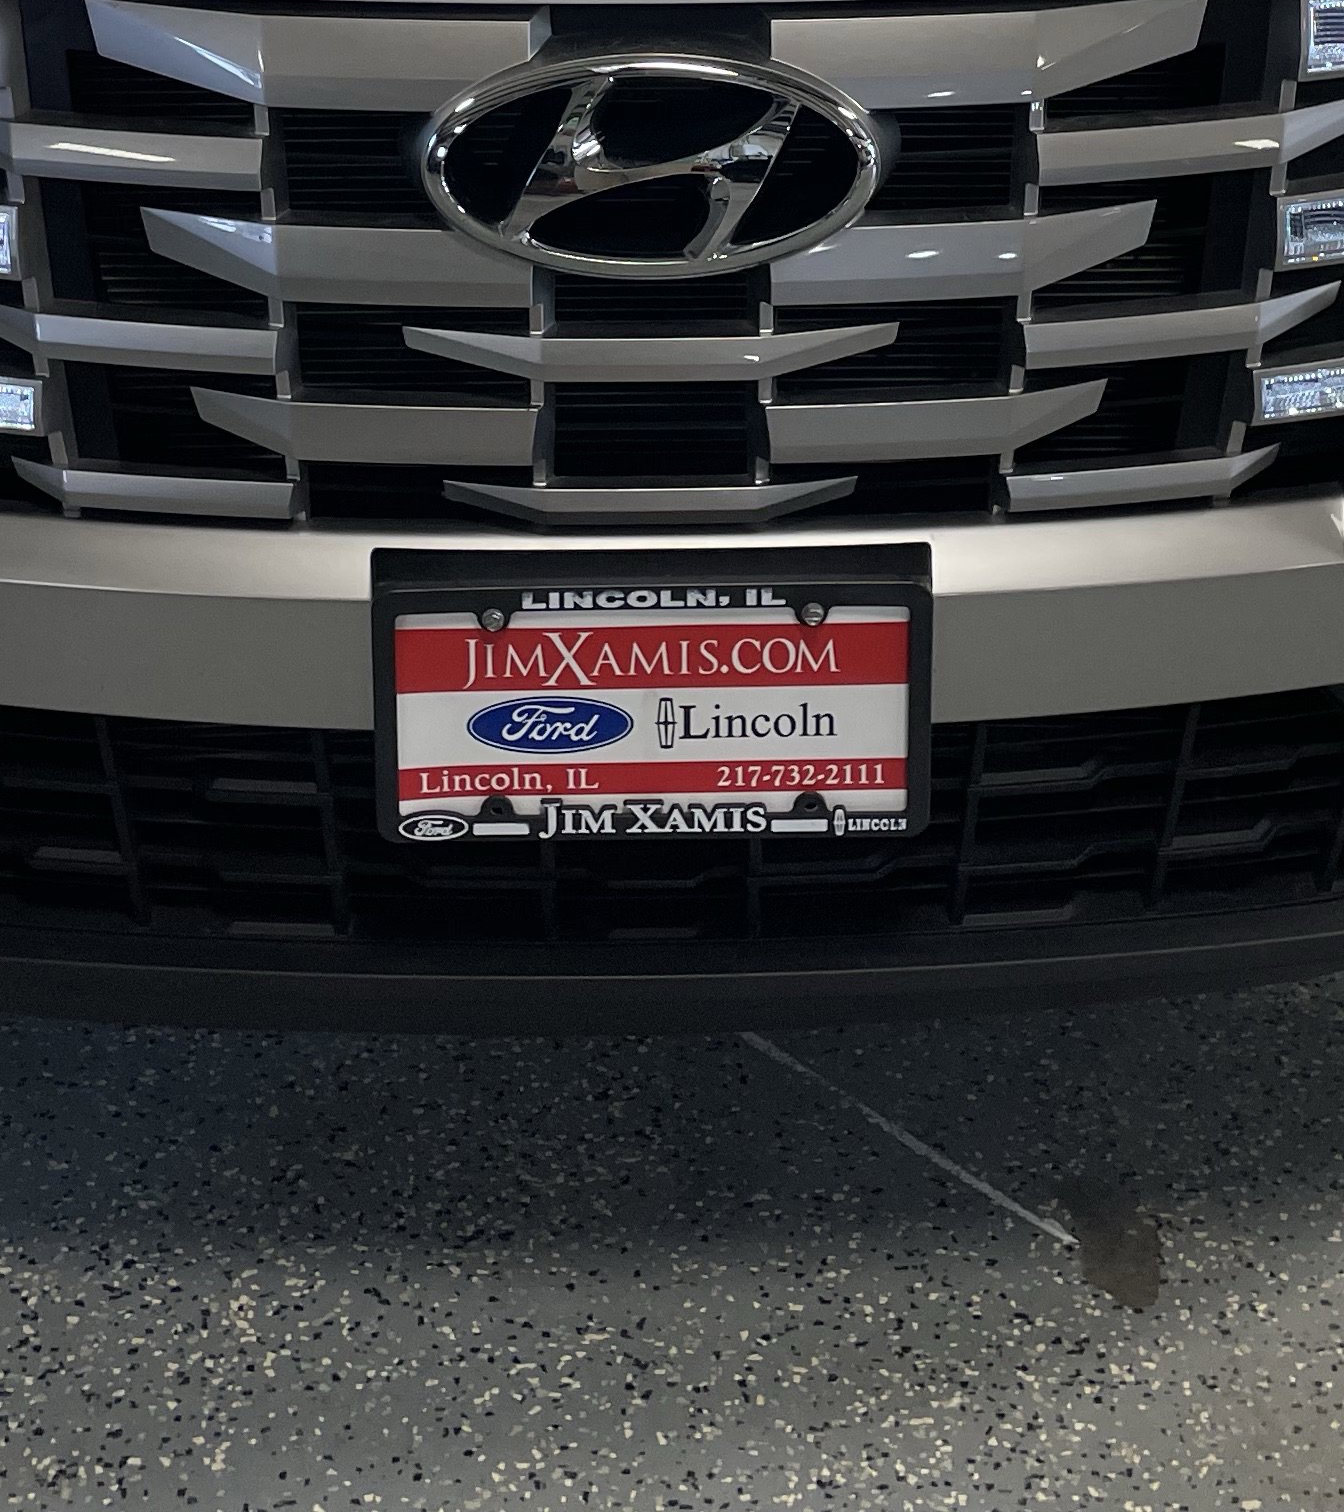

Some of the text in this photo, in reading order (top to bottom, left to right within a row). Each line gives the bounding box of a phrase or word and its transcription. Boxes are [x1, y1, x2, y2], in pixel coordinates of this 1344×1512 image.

[521, 588, 786, 610] LINCOLN, IL
[501, 704, 600, 743] Ford
[679, 703, 838, 741] Lincoln
[419, 769, 599, 794] Lincoln, IL
[717, 765, 886, 788] 217-732-2111
[413, 819, 454, 838] Ford
[848, 817, 907, 832] LINCOLN
